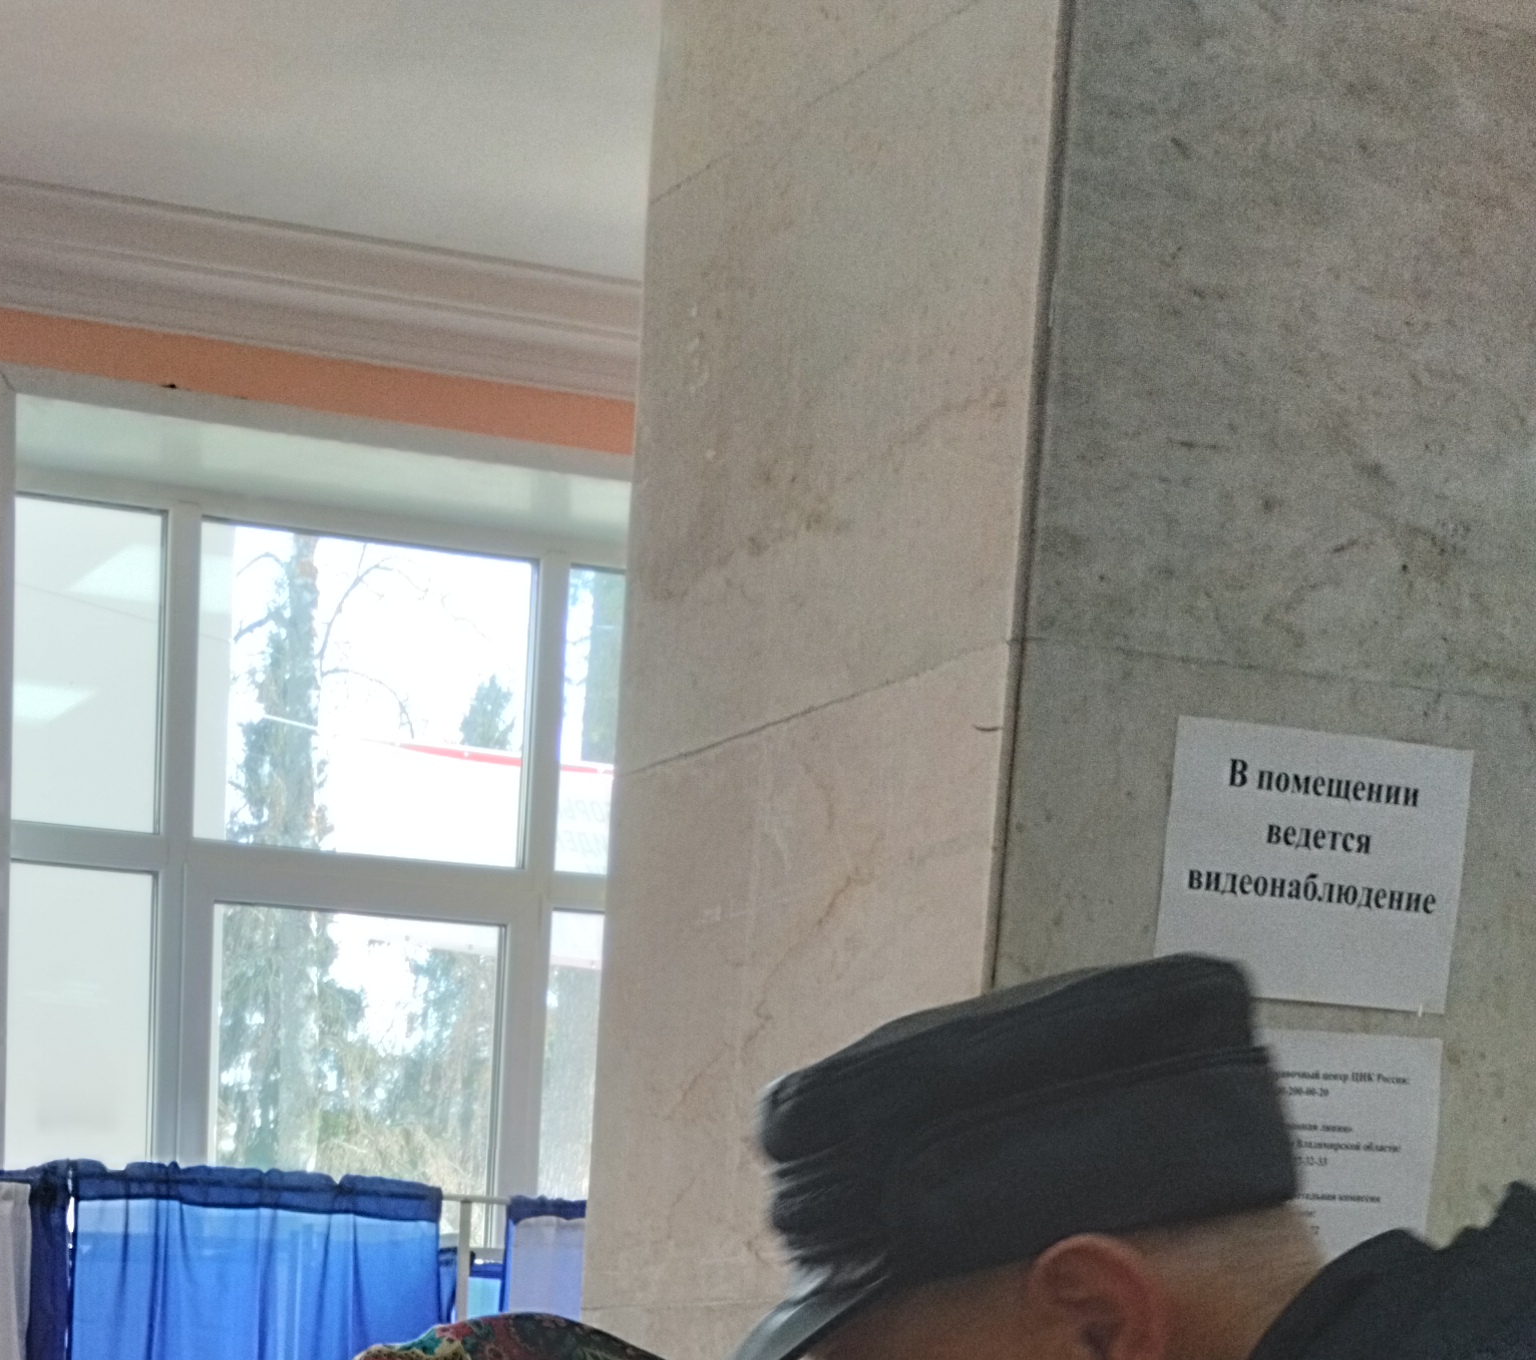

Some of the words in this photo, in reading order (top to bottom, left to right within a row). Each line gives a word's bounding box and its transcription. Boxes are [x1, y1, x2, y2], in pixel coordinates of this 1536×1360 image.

[1228, 757, 1249, 788] В
[1257, 769, 1420, 808] помещении
[1266, 823, 1372, 855] ведется
[1187, 868, 1437, 915] видеонаблюдение
